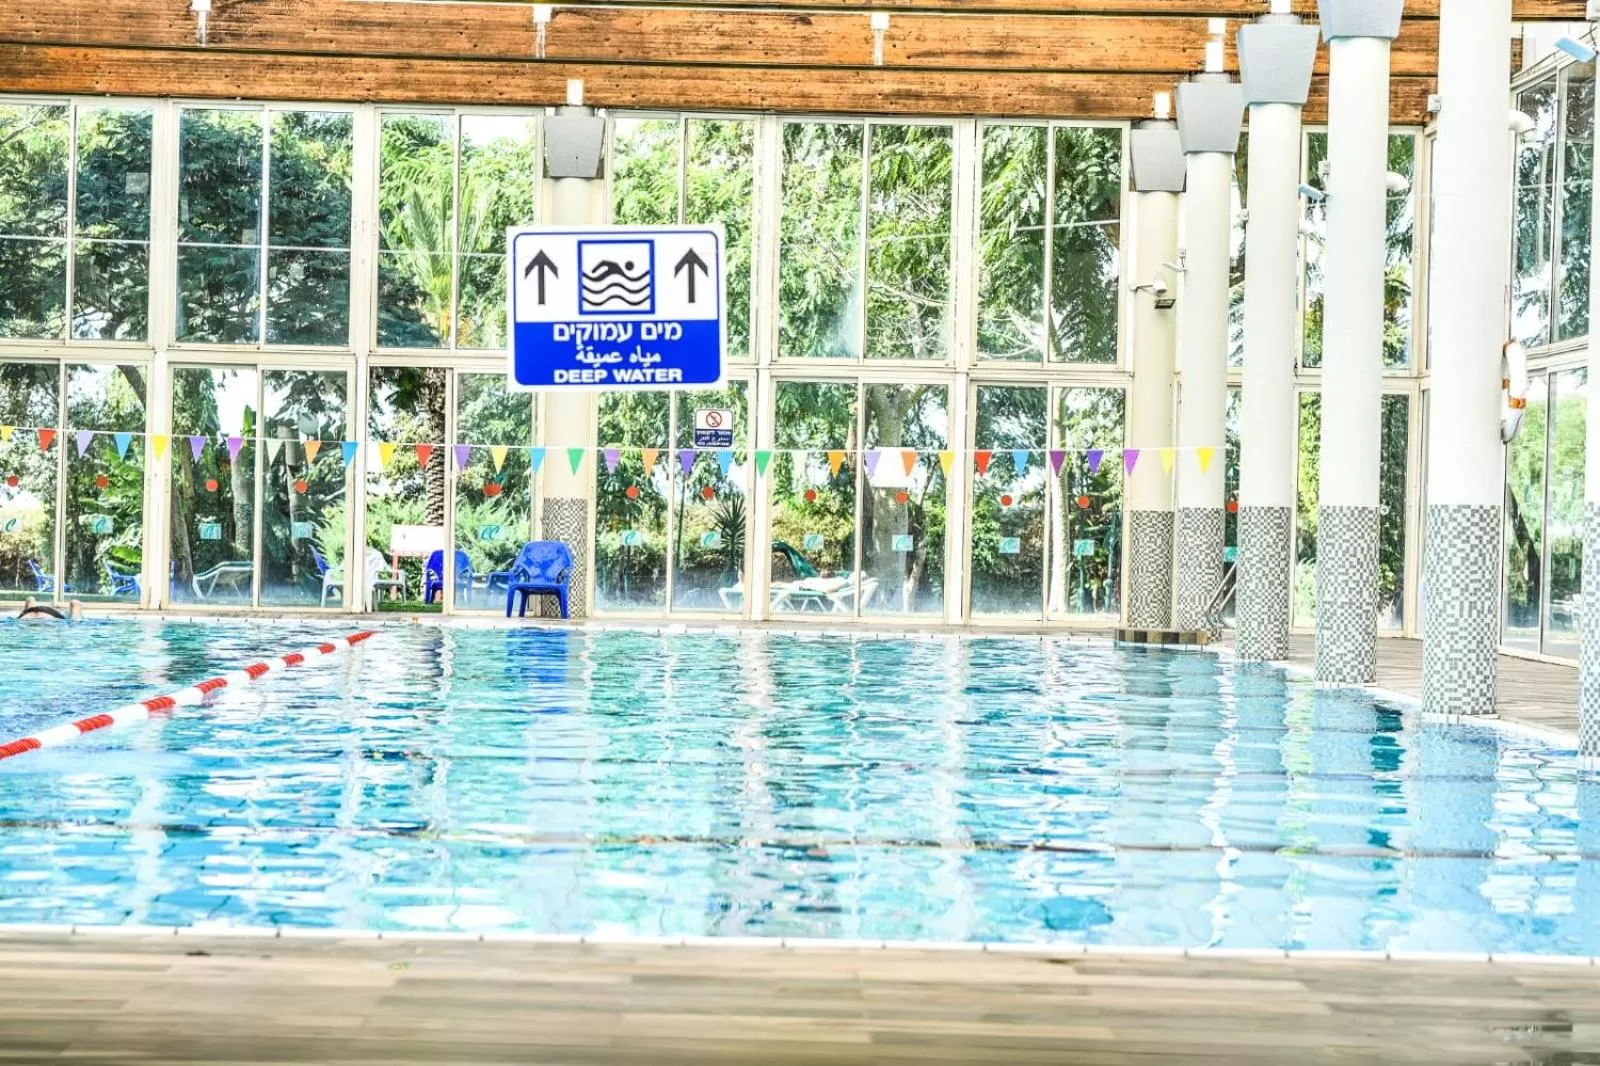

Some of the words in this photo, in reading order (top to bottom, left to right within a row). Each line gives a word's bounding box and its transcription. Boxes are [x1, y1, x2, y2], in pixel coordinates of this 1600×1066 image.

[553, 322, 633, 346] עמוקים
[641, 322, 683, 341] מים
[575, 345, 624, 369] عميقة
[629, 344, 662, 368] مياه
[553, 369, 608, 384] DEEP
[612, 368, 683, 383] WATER
